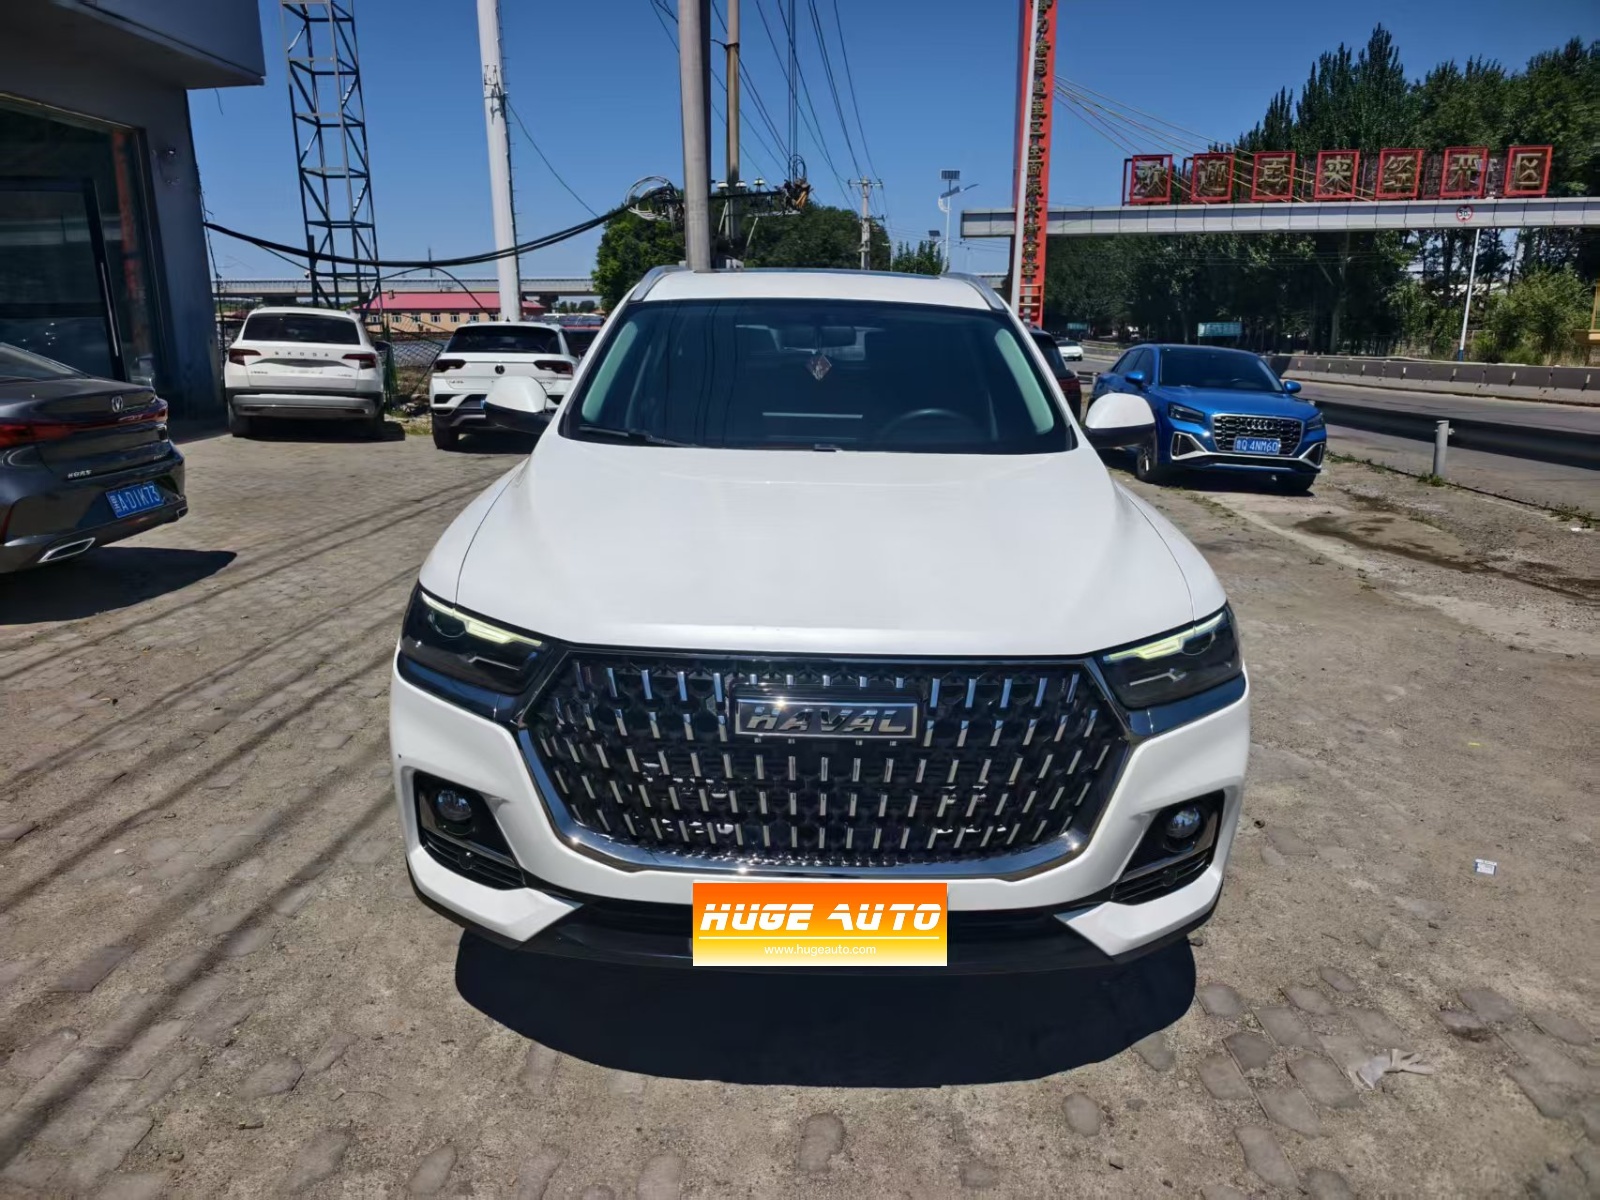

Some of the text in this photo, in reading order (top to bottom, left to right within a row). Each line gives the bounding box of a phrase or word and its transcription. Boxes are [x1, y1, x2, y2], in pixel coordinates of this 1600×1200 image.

[1134, 153, 1543, 196] 欢迎再来经开区
[746, 706, 907, 732] HAVAL
